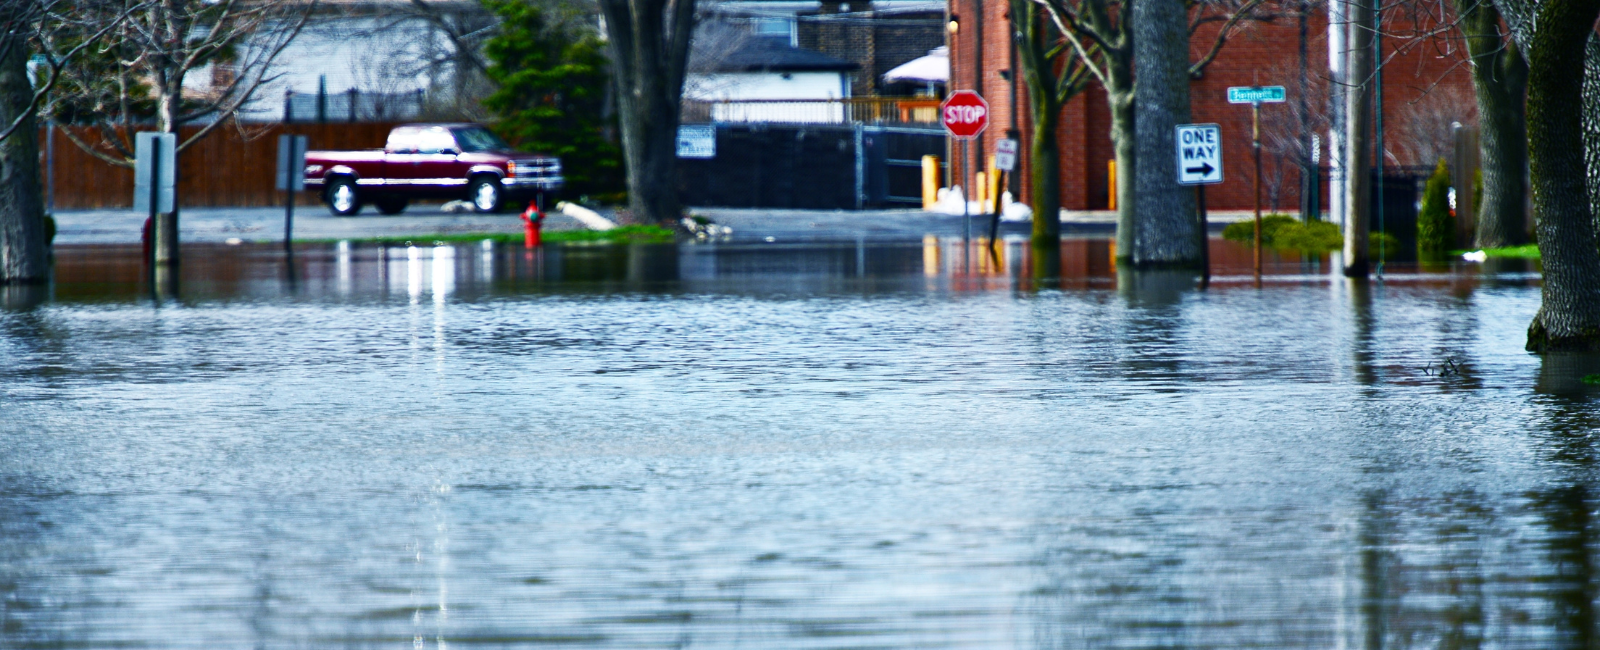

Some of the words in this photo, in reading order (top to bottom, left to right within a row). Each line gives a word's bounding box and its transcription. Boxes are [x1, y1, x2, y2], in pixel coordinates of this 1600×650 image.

[946, 105, 986, 124] STOP
[1182, 129, 1216, 144] ONE
[1182, 146, 1217, 160] WAY
